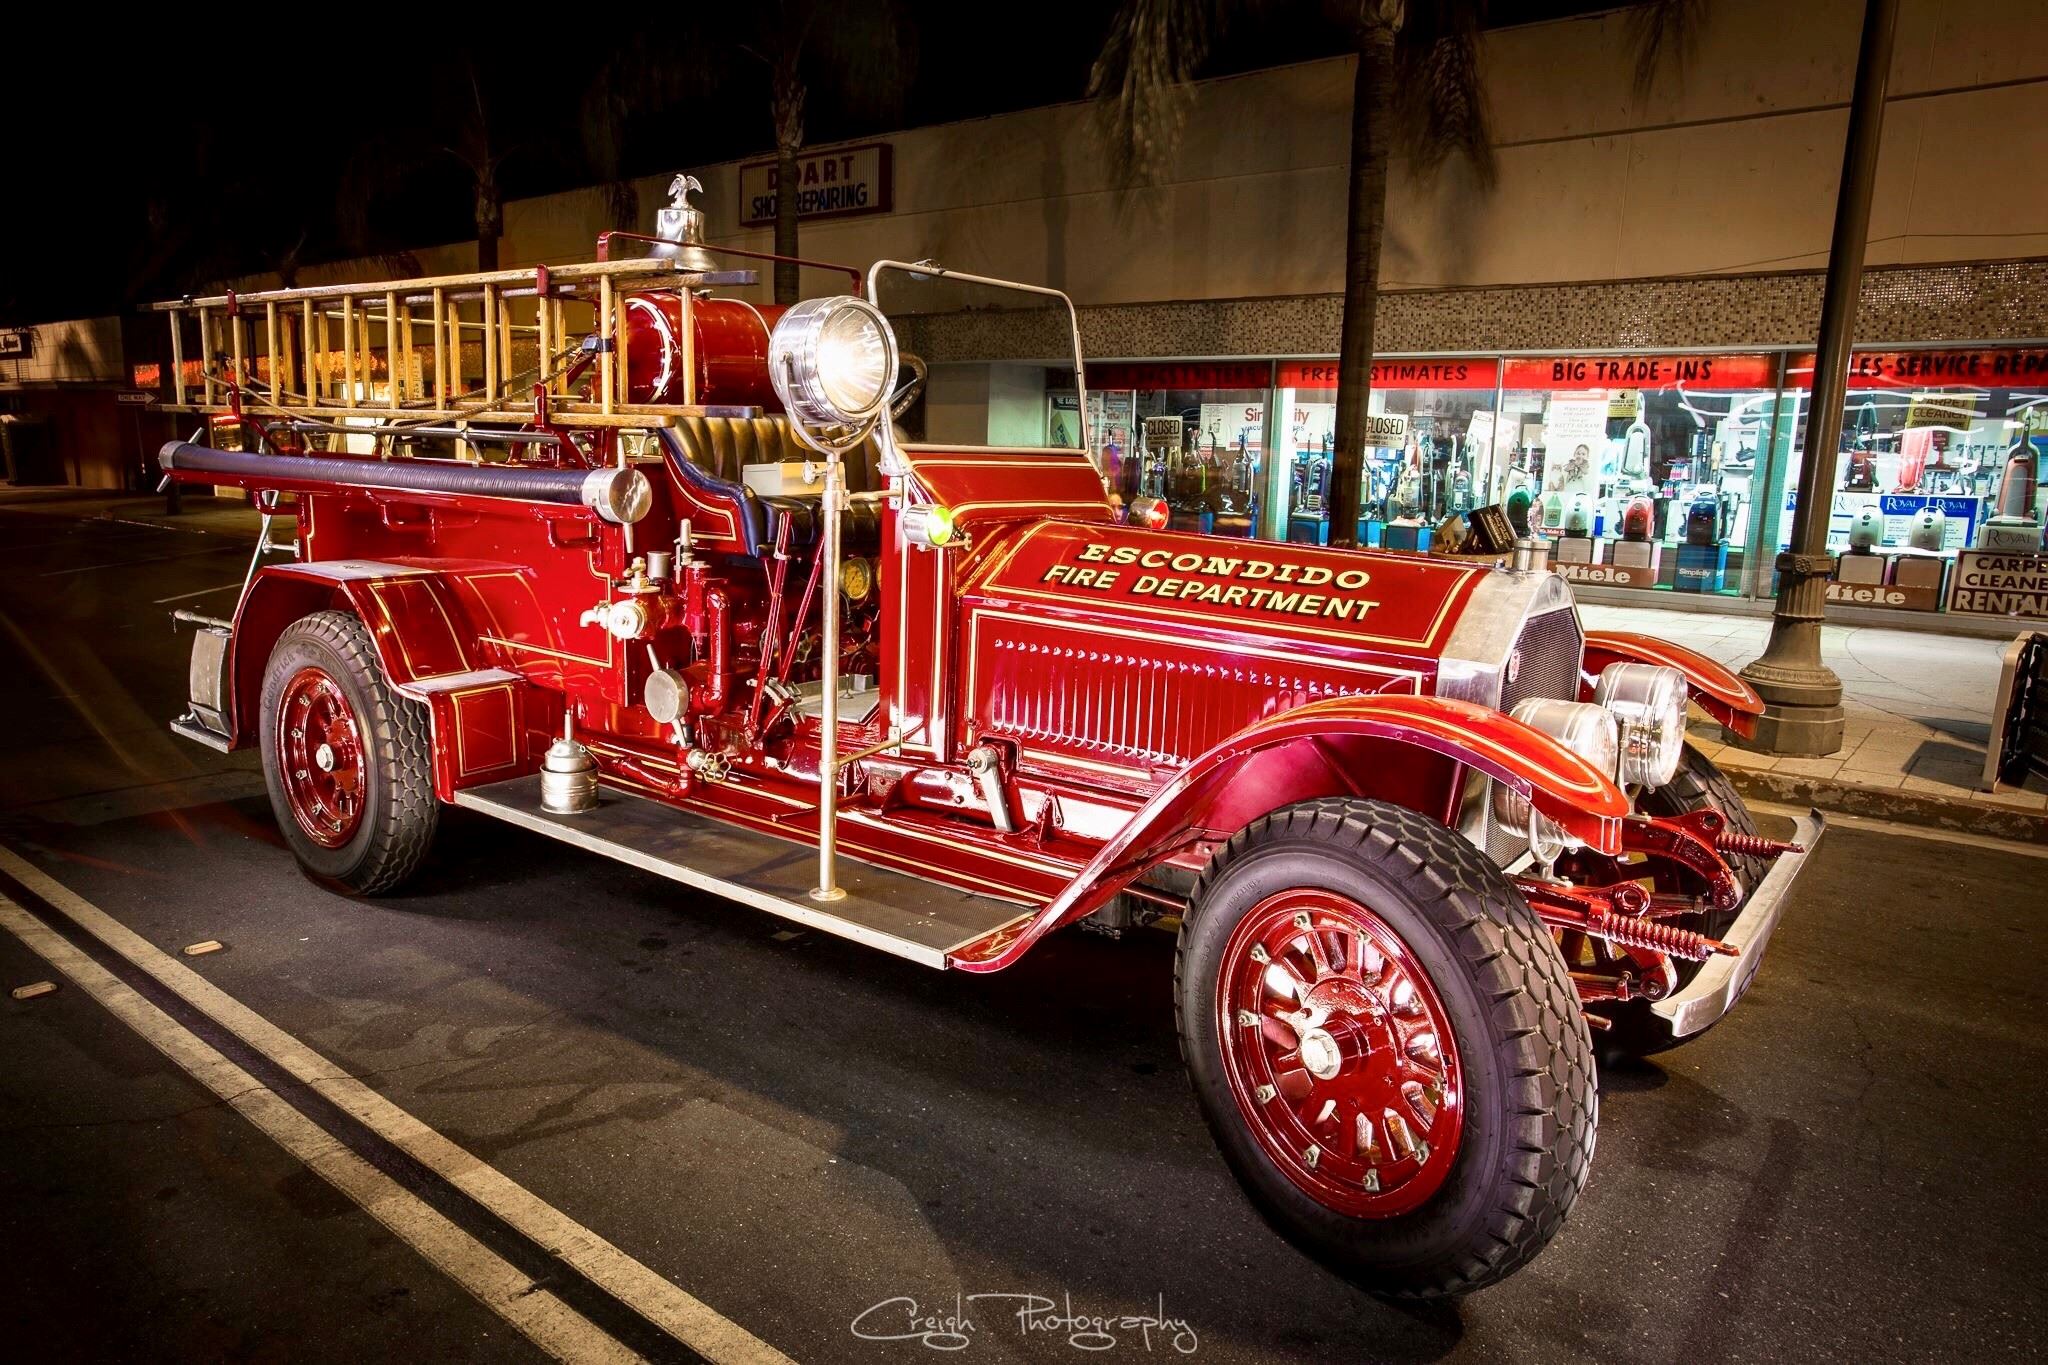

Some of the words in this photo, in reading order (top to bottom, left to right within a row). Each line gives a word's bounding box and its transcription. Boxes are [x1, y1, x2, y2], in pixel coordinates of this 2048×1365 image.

[752, 194, 777, 219] SHO
[795, 183, 868, 213] REPAIRING
[1302, 367, 1340, 382] FRE
[1370, 365, 1468, 382] STIMATES
[1552, 361, 1587, 381] BIG
[1595, 360, 1713, 381] TRADE-INS
[1147, 419, 1180, 435] CLOSED
[1366, 416, 1404, 435] CLOSED
[1886, 497, 1919, 510] ROYAL
[1986, 528, 2033, 546] ROYAL
[1079, 544, 1371, 589] ESCONDIDO
[1556, 564, 1631, 584] Miele
[1679, 568, 1711, 578] Simplicity
[1044, 565, 1121, 589] FIRE
[1133, 577, 1379, 621] DEPARTMENT
[1955, 590, 2048, 615] RENTAL
